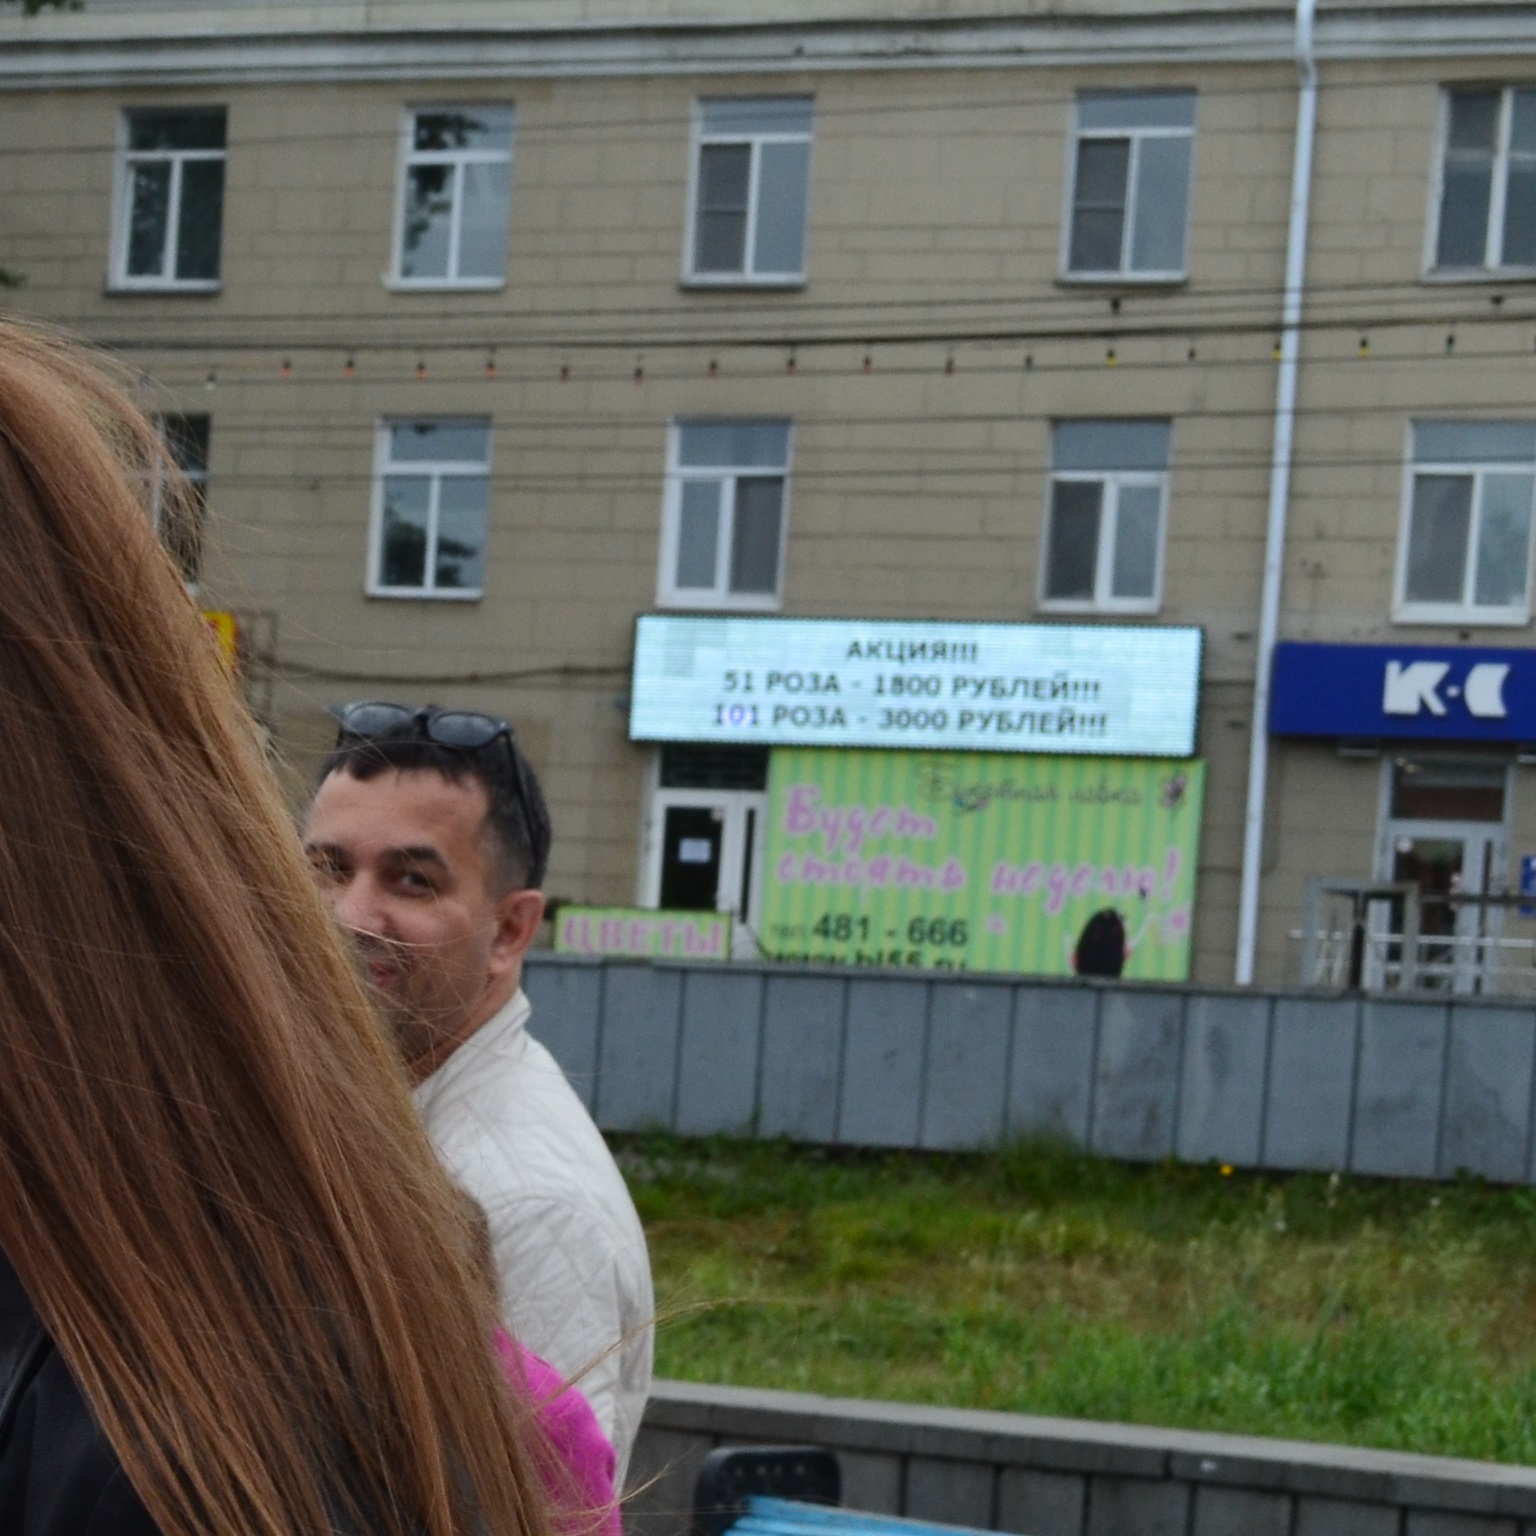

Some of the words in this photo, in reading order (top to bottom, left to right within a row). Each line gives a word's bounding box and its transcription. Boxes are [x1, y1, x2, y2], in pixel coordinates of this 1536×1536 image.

[847, 640, 979, 664] АКЦИЯ!!!
[724, 671, 754, 692] 51
[767, 671, 840, 693] РОЗА
[875, 674, 941, 696] 1800
[953, 671, 1100, 701] РУБЛЕЙ!!!
[715, 703, 759, 727] 101
[773, 704, 846, 728] РОЗА
[879, 708, 948, 730] 3000
[957, 707, 1107, 735] РУБЛЕЙ!!!
[784, 784, 937, 853] Будет
[564, 912, 724, 956] ЦВЕТЫ
[813, 914, 872, 942] 481
[907, 917, 968, 947] 666
